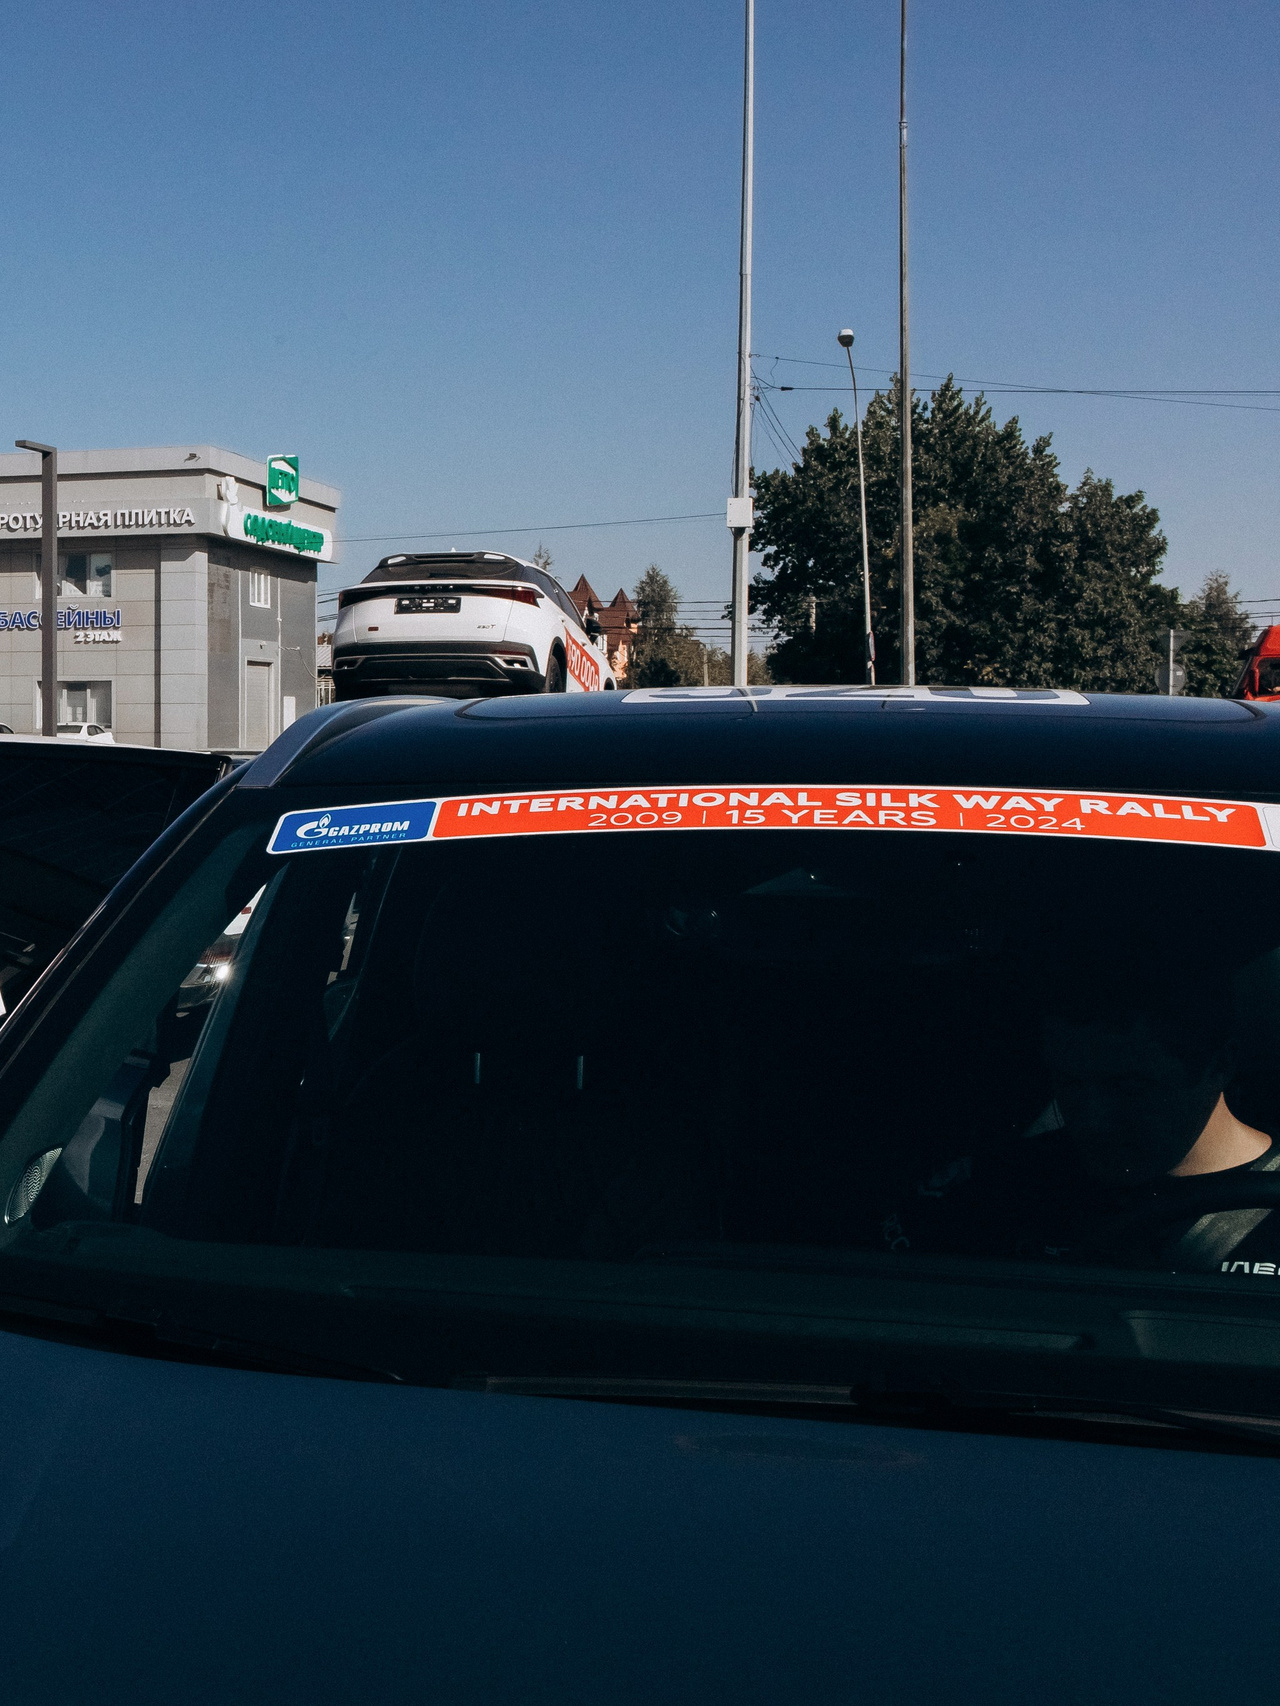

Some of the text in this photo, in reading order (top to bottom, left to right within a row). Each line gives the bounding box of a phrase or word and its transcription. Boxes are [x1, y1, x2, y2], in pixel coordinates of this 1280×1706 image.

[117, 507, 195, 526] ПЛИТКА
[75, 631, 122, 642] 2 ЭТАЖ
[458, 792, 1236, 823] INTERNATIONAL SILK WAY RALLY
[328, 820, 410, 837] GAZPROM
[587, 809, 1086, 831] 2009 15 YEARS 2024
[290, 832, 407, 848] GENERAL PARTNER
